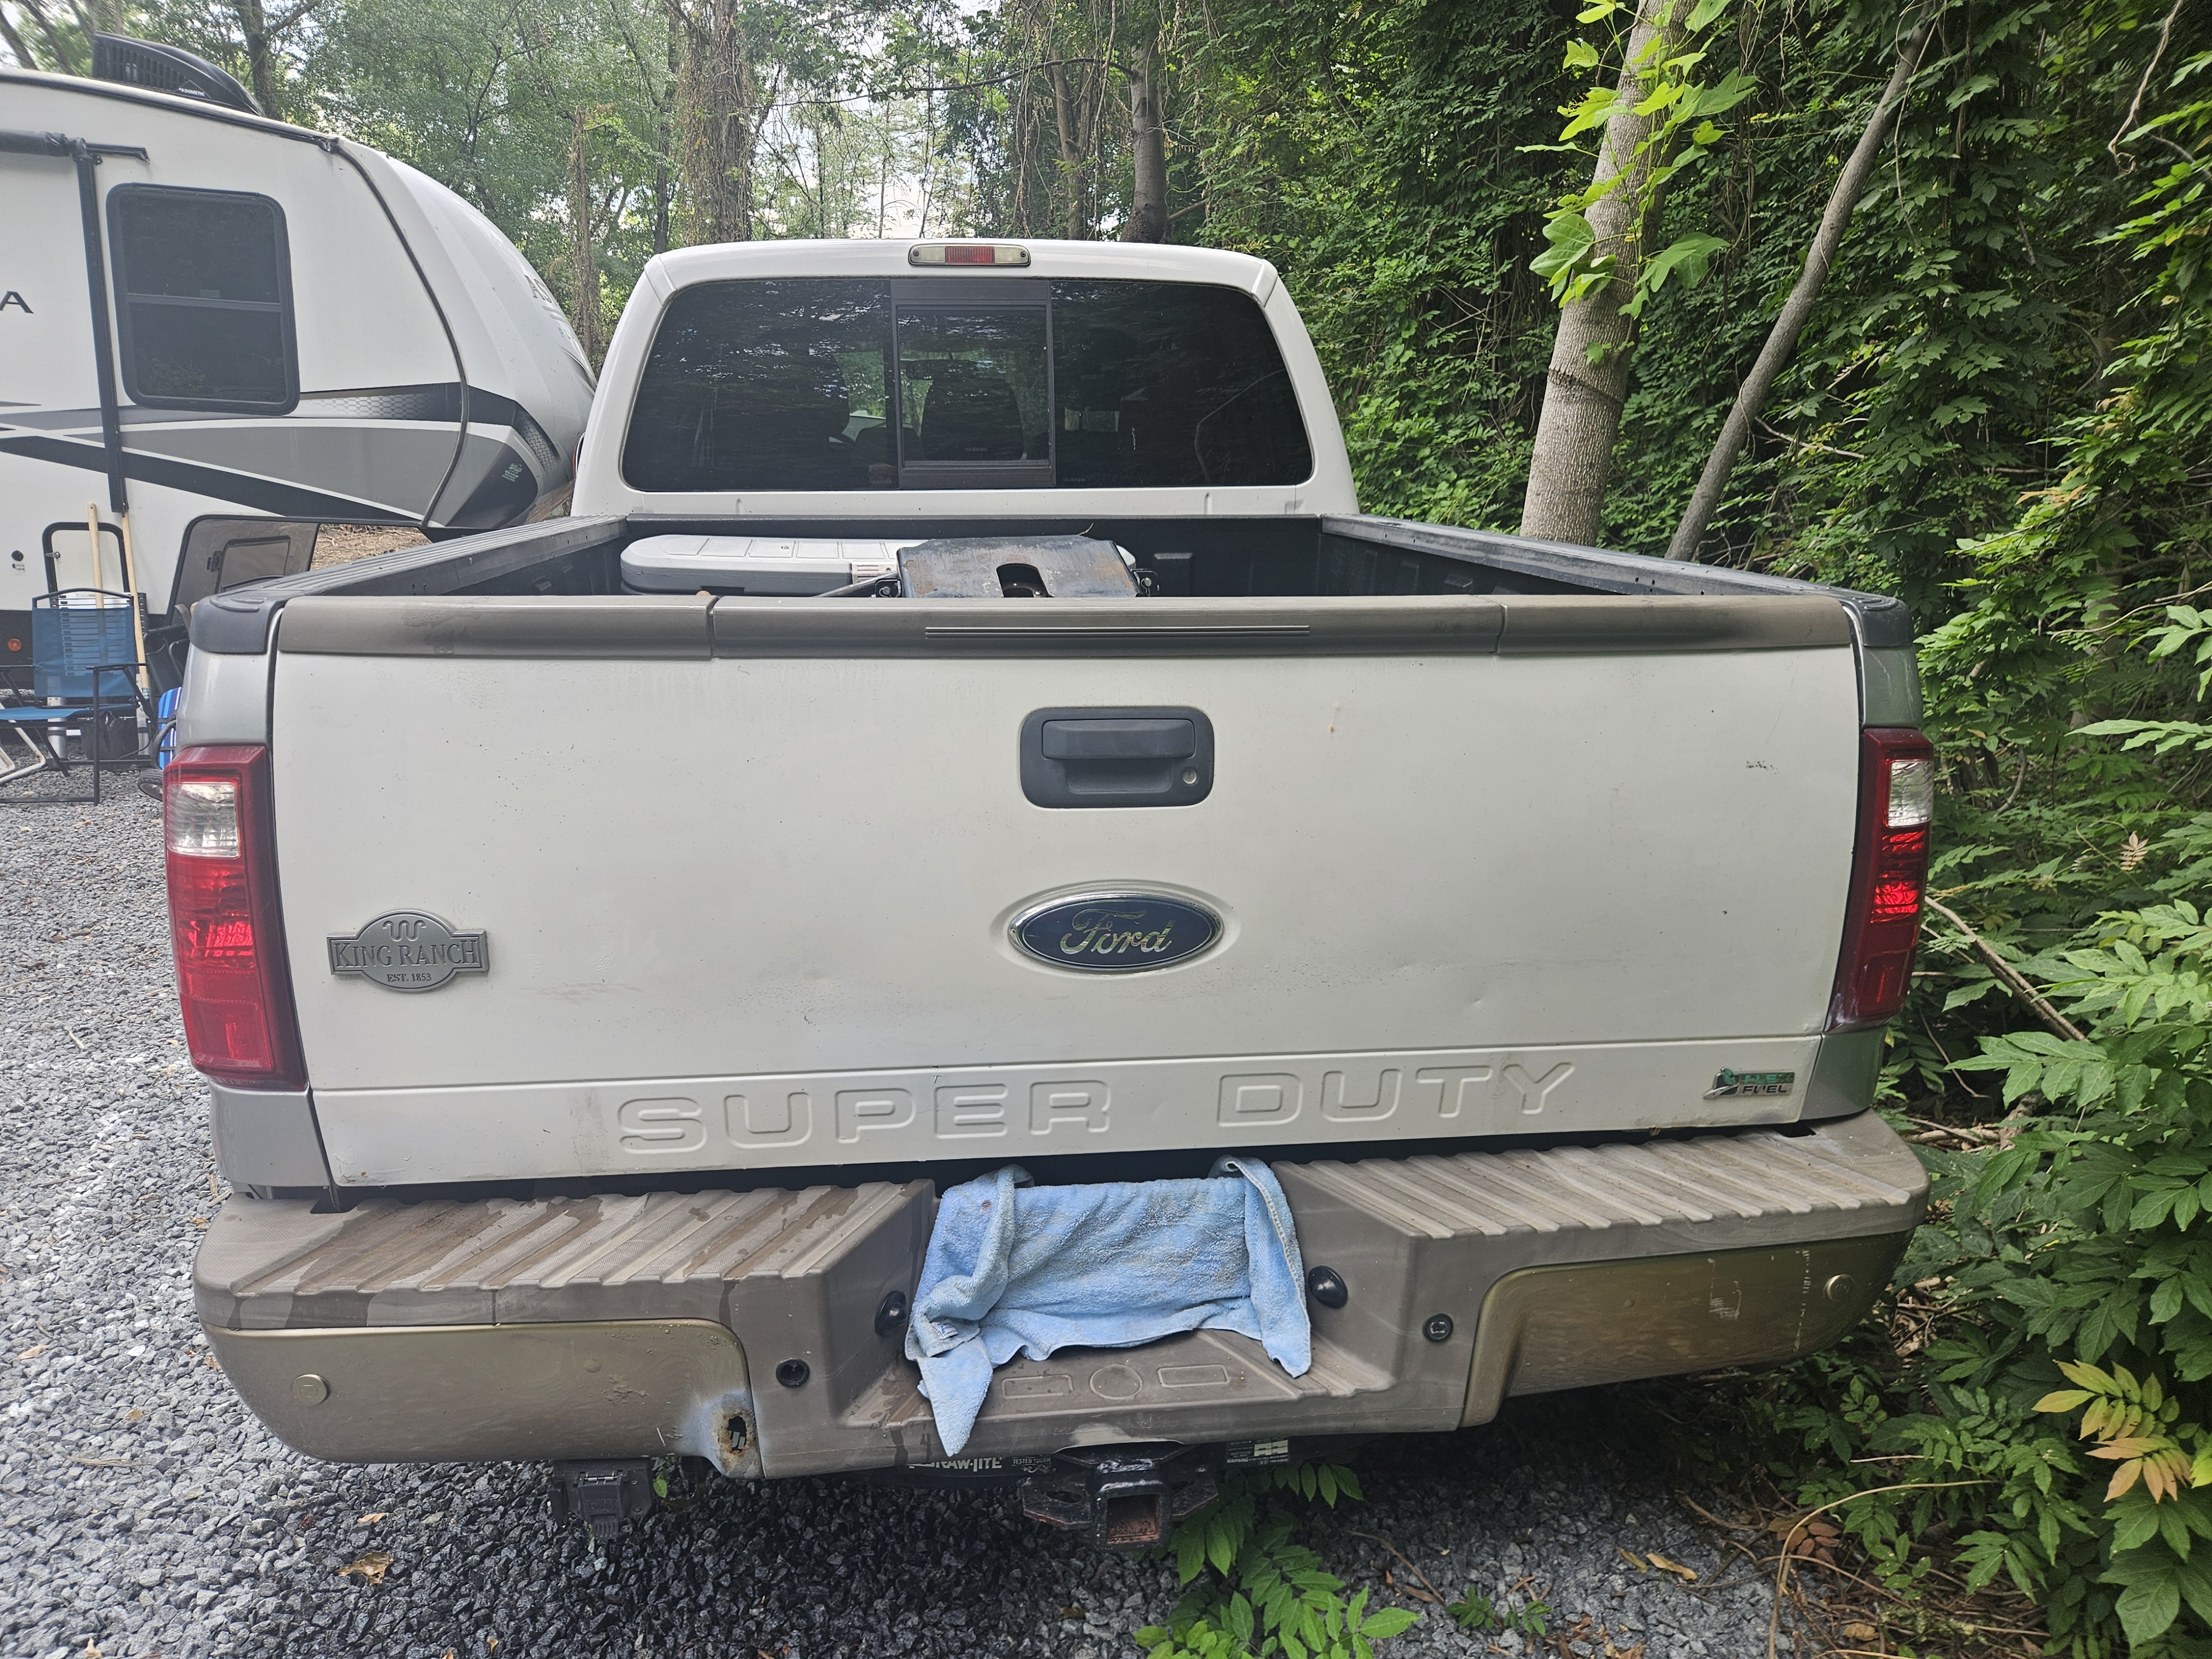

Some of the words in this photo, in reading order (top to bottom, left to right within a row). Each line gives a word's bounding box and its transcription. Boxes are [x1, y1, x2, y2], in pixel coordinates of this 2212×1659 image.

[1060, 908, 1176, 955] Ford
[333, 942, 393, 968] KING
[397, 940, 479, 967] RANCH
[387, 973, 409, 983] EST.
[411, 972, 432, 982] 1853
[1741, 1084, 1788, 1094] FUEL
[617, 1078, 1112, 1155] SUPER
[1217, 1061, 1576, 1128] DUTY
